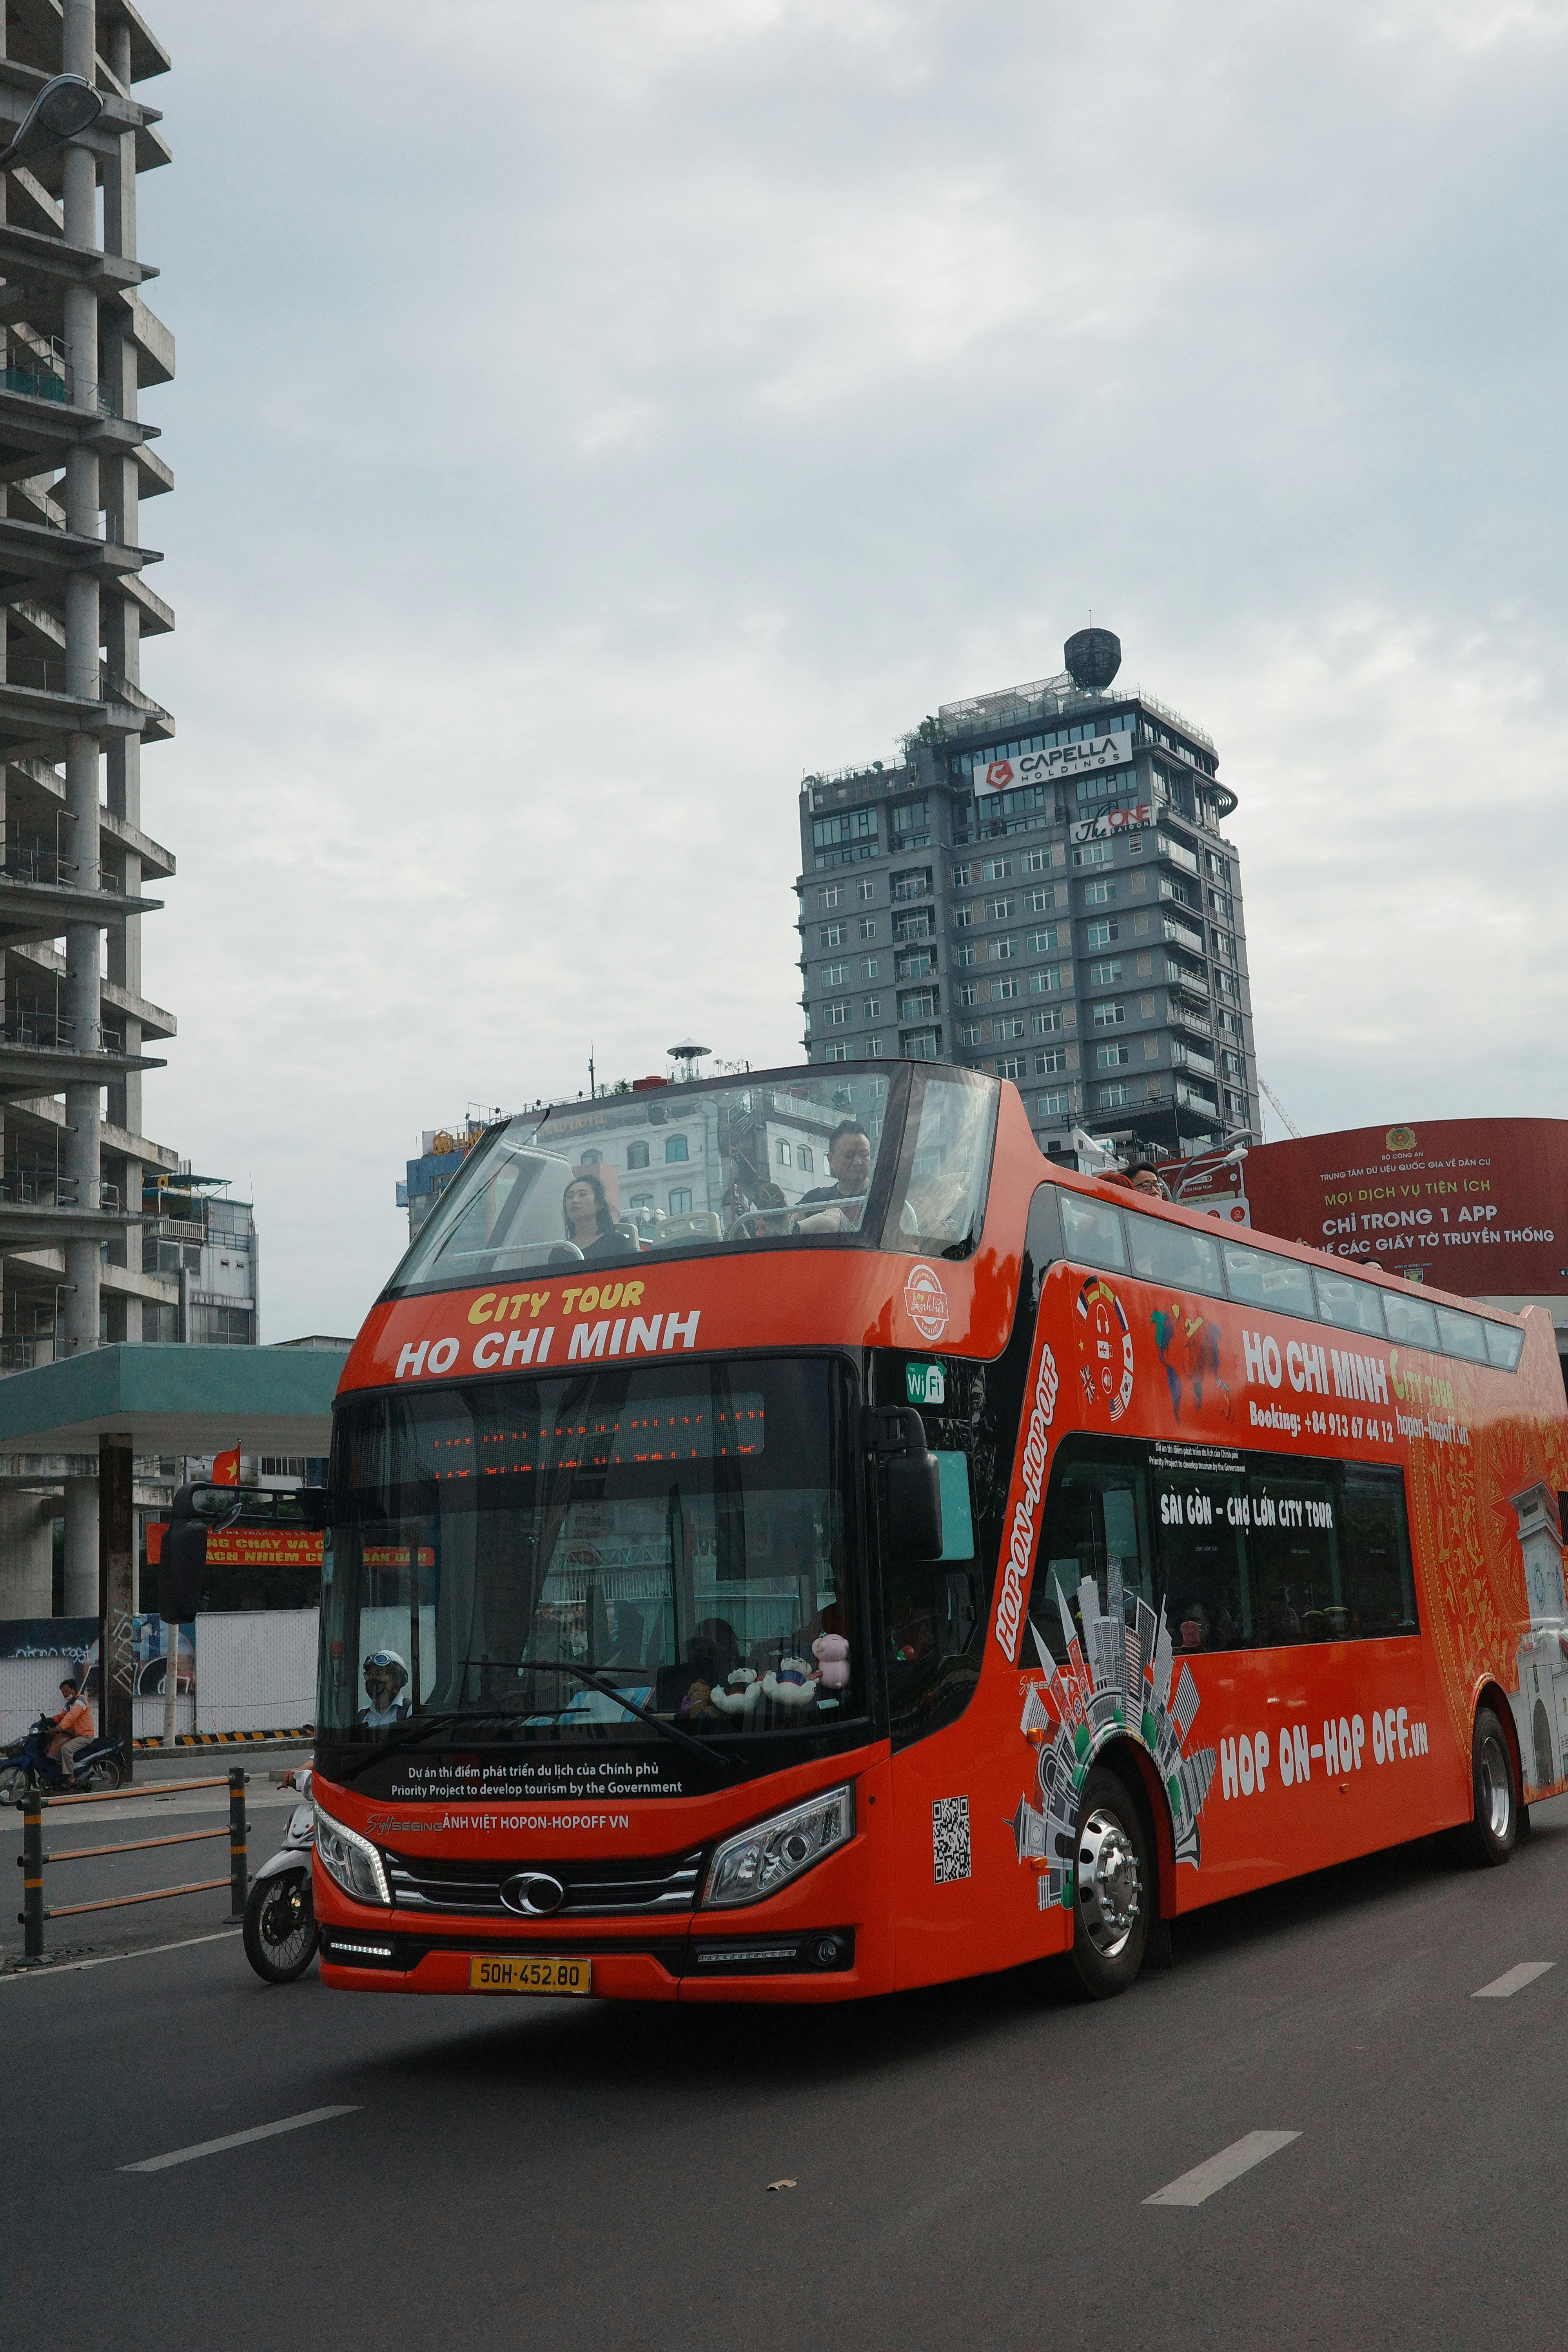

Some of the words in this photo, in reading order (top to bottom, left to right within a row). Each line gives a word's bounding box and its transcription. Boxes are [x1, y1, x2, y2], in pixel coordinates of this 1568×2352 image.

[1020, 738, 1117, 772] CAPELLA
[1022, 753, 1120, 782] HOLDINGS
[1076, 803, 1114, 840] The
[1109, 803, 1150, 827] ONE
[1111, 820, 1149, 834] SAIGON
[1320, 1171, 1346, 1181] TRUNG
[1347, 1168, 1364, 1177] TÂM
[1367, 1165, 1378, 1174] DỮ
[1380, 1163, 1396, 1174] LIỆU
[1399, 1160, 1426, 1171] QUỐC
[1458, 1158, 1476, 1167] DÂN
[1479, 1158, 1491, 1166] CƯ
[1325, 1191, 1352, 1206] MỌI
[1359, 1186, 1396, 1201] DỊCH
[1400, 1184, 1420, 1197] VỤ
[1425, 1180, 1457, 1196] TIỆN
[1464, 1178, 1490, 1192] ÍCH
[1322, 1212, 1356, 1236] CHỈ
[1361, 1209, 1433, 1229] TRONG
[1440, 1208, 1449, 1223] 1
[1458, 1205, 1497, 1222] APP
[1338, 1238, 1371, 1256] CÁC
[1376, 1232, 1414, 1250] GIẤY
[1418, 1230, 1439, 1247] TỜ
[1443, 1226, 1500, 1245] TRUYỀN
[1503, 1226, 1554, 1243] THỐNG
[468, 1291, 550, 1325] CITY
[561, 1280, 646, 1315] TOUR
[922, 1321, 939, 1334] tourist
[394, 1337, 460, 1379] HO
[472, 1326, 555, 1368] CHI
[568, 1310, 701, 1359] MINH
[1242, 1330, 1282, 1388] HO
[1287, 1341, 1329, 1395] CHI
[1330, 1349, 1389, 1405] MINH
[1390, 1348, 1422, 1403] CITY
[1425, 1375, 1455, 1410] TOUR
[1249, 1401, 1301, 1437] Booking:
[1305, 1410, 1326, 1434] +84
[1328, 1413, 1348, 1437] 913
[1351, 1416, 1363, 1439] 67
[1367, 1418, 1379, 1441] 44
[1381, 1421, 1394, 1443] 12
[1396, 1406, 1469, 1449] hopon-hopoff.vn
[1149, 1456, 1164, 1468] Priority
[1165, 1457, 1178, 1469] Project
[1178, 1459, 1183, 1468] to
[1183, 1459, 1198, 1471] develop
[1198, 1461, 1212, 1470] tourism
[1212, 1462, 1217, 1472] by
[1224, 1463, 1246, 1472] Government
[1202, 1448, 1207, 1456] du
[1161, 1485, 1183, 1524] SÀI
[1187, 1487, 1212, 1525] GÒN
[1227, 1494, 1250, 1535] CHỢ
[1253, 1486, 1276, 1526] LỚN
[1278, 1499, 1302, 1527] CITY
[1305, 1501, 1333, 1529] TOUR
[245, 1551, 299, 1563] NHIỆM
[1220, 1730, 1270, 1801] HOP
[1372, 1706, 1429, 1765] OFF.VN
[408, 1767, 423, 1781] Dự
[425, 1766, 436, 1778] án
[439, 1766, 452, 1778] thí
[455, 1764, 480, 1778] điểm
[483, 1765, 507, 1779] phát
[509, 1763, 534, 1777] triển
[537, 1764, 552, 1776] du
[554, 1764, 573, 1779] lịch
[577, 1763, 596, 1775] của
[599, 1763, 632, 1775] Chính
[636, 1762, 659, 1777] phủ
[392, 1784, 427, 1798] Priority
[430, 1784, 465, 1798] Project
[467, 1785, 477, 1795] to
[480, 1783, 522, 1797] develop
[524, 1783, 567, 1794] tourism
[570, 1782, 584, 1797] by
[586, 1782, 605, 1793] the
[608, 1781, 682, 1793] Government
[443, 1812, 468, 1829] ẢNH
[470, 1814, 497, 1834] VIỆT
[501, 1815, 606, 1829] HOPON-HOPOFF
[609, 1815, 628, 1828] VN
